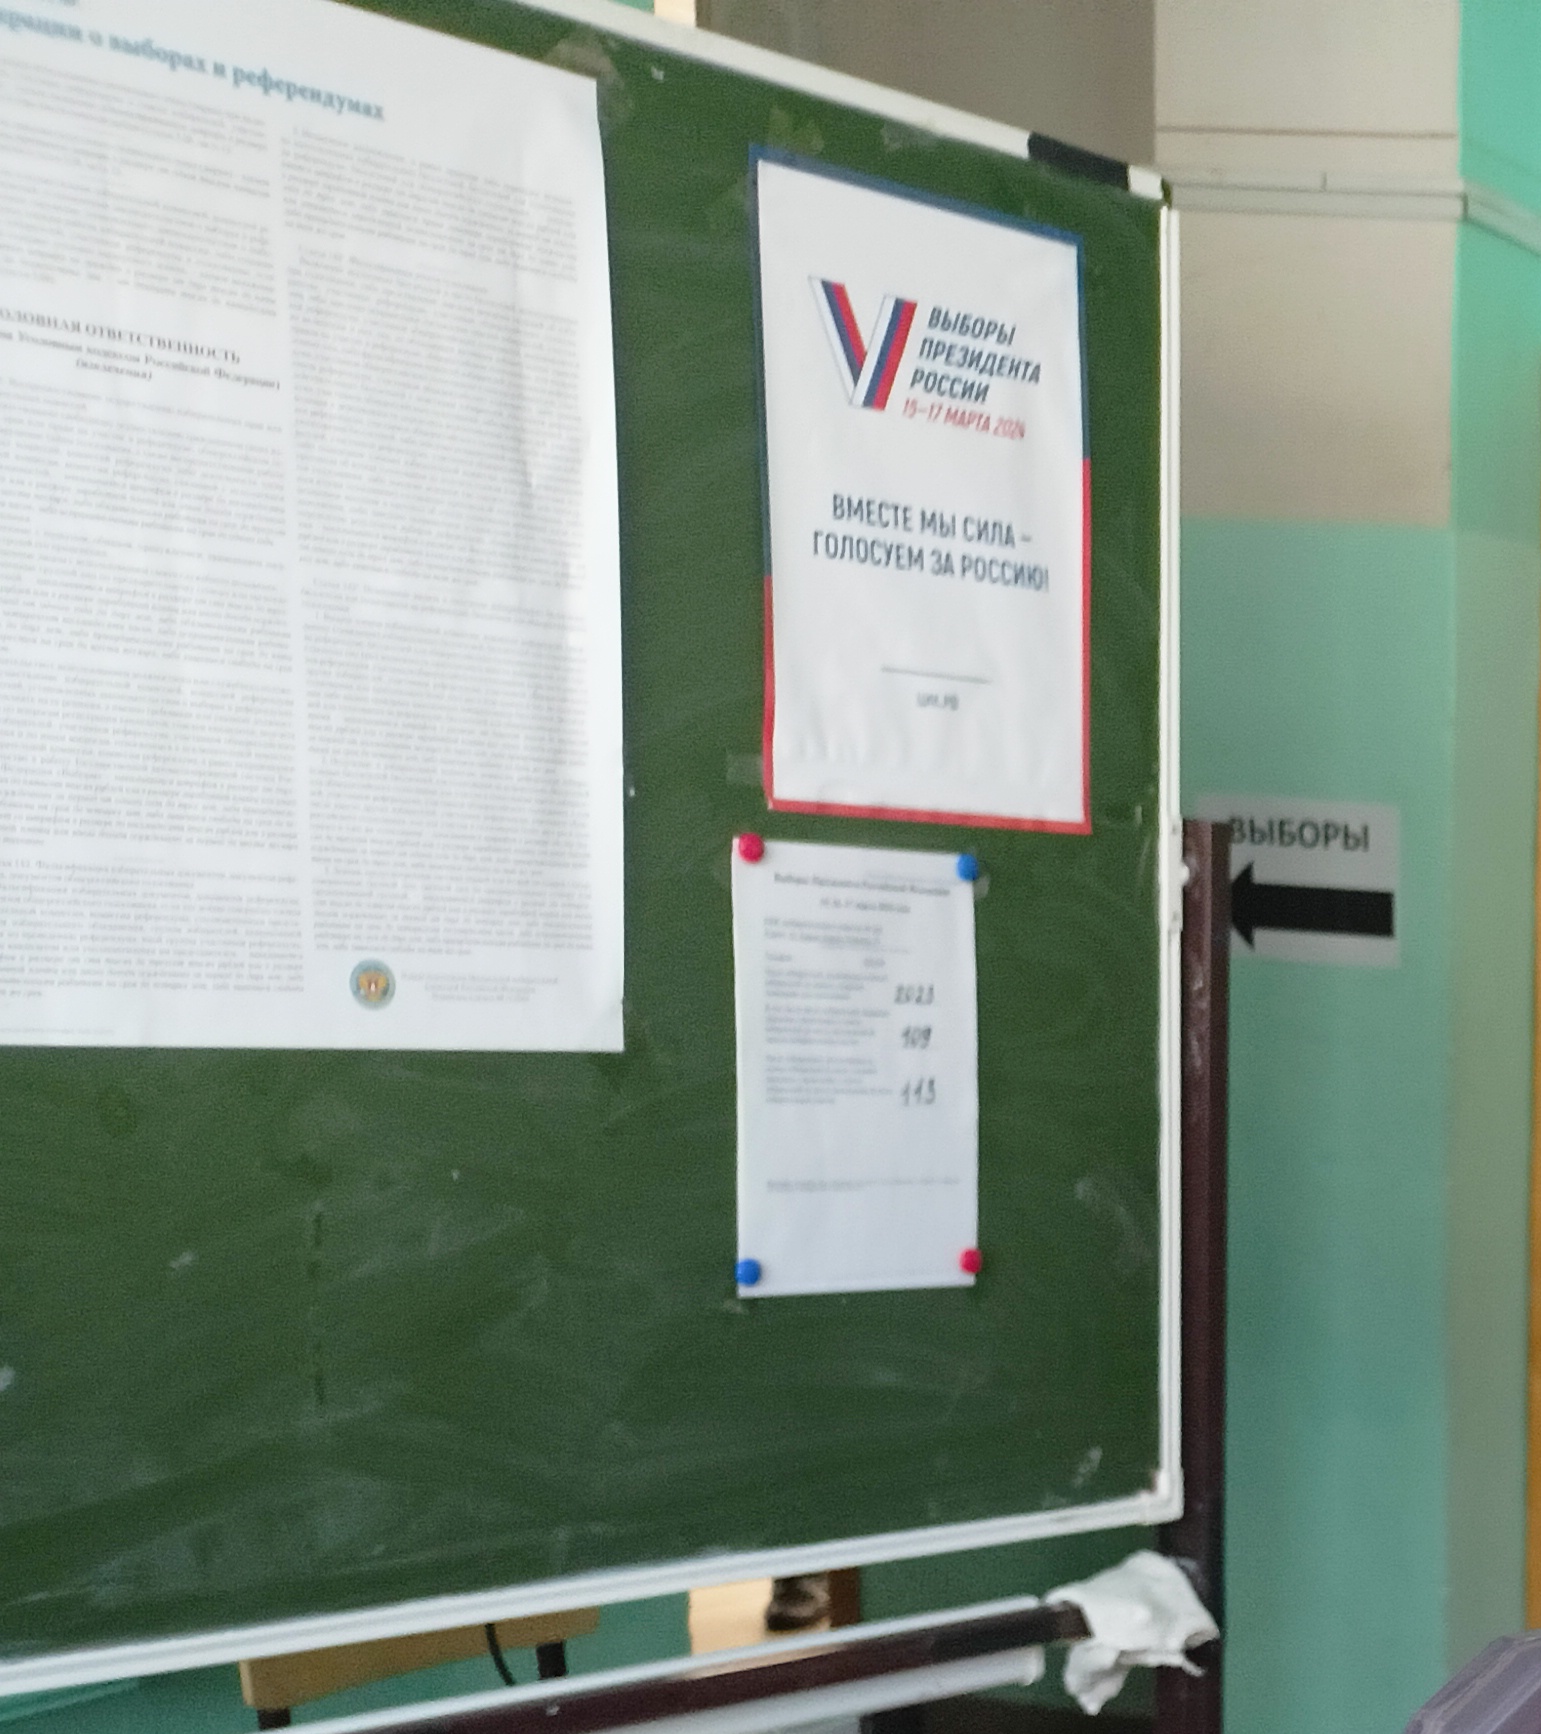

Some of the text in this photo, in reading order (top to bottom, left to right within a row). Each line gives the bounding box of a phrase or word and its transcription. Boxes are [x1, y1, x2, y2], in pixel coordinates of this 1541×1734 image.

[109, 35, 206, 72] выборах
[213, 61, 226, 78] и
[232, 67, 384, 121] референдумах
[927, 305, 1016, 346] ВЫБОРЫ
[919, 337, 1042, 384] ПРЕЗИДЕНТА
[910, 368, 990, 405] РОССИИ
[944, 406, 991, 433] МАРТА
[993, 416, 1026, 439] 2024
[832, 493, 913, 532] ВМЕСТЕ
[919, 508, 957, 540] МЫ
[963, 515, 1016, 549] СИЛА
[812, 529, 1050, 593] ГОЛОСУЕМ ЗА РОССИЮ!
[1228, 817, 1370, 852] ВЫБОРЫ
